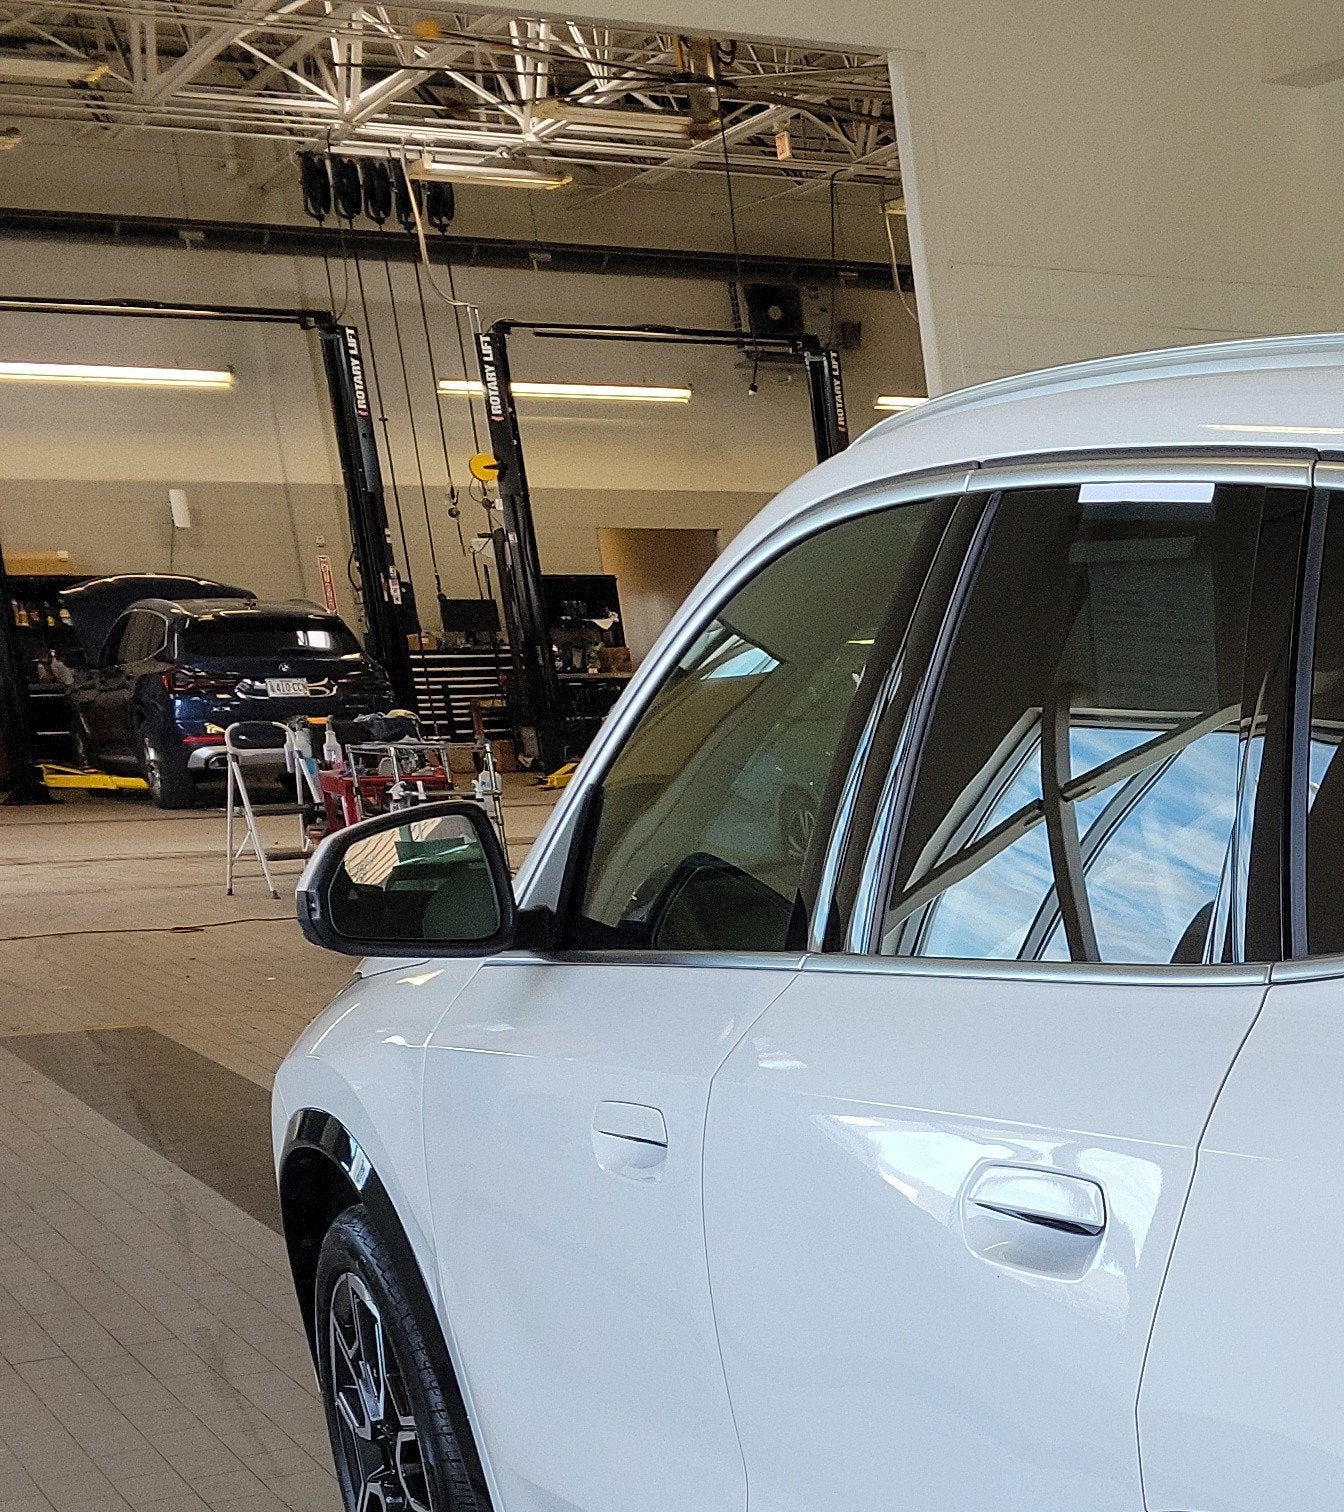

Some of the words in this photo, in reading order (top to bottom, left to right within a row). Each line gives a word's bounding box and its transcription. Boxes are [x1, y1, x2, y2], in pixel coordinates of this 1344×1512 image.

[345, 327, 358, 355] LIFT
[480, 334, 494, 361] LIFT
[350, 357, 367, 409] ROTARY
[485, 364, 502, 415] ROTARY
